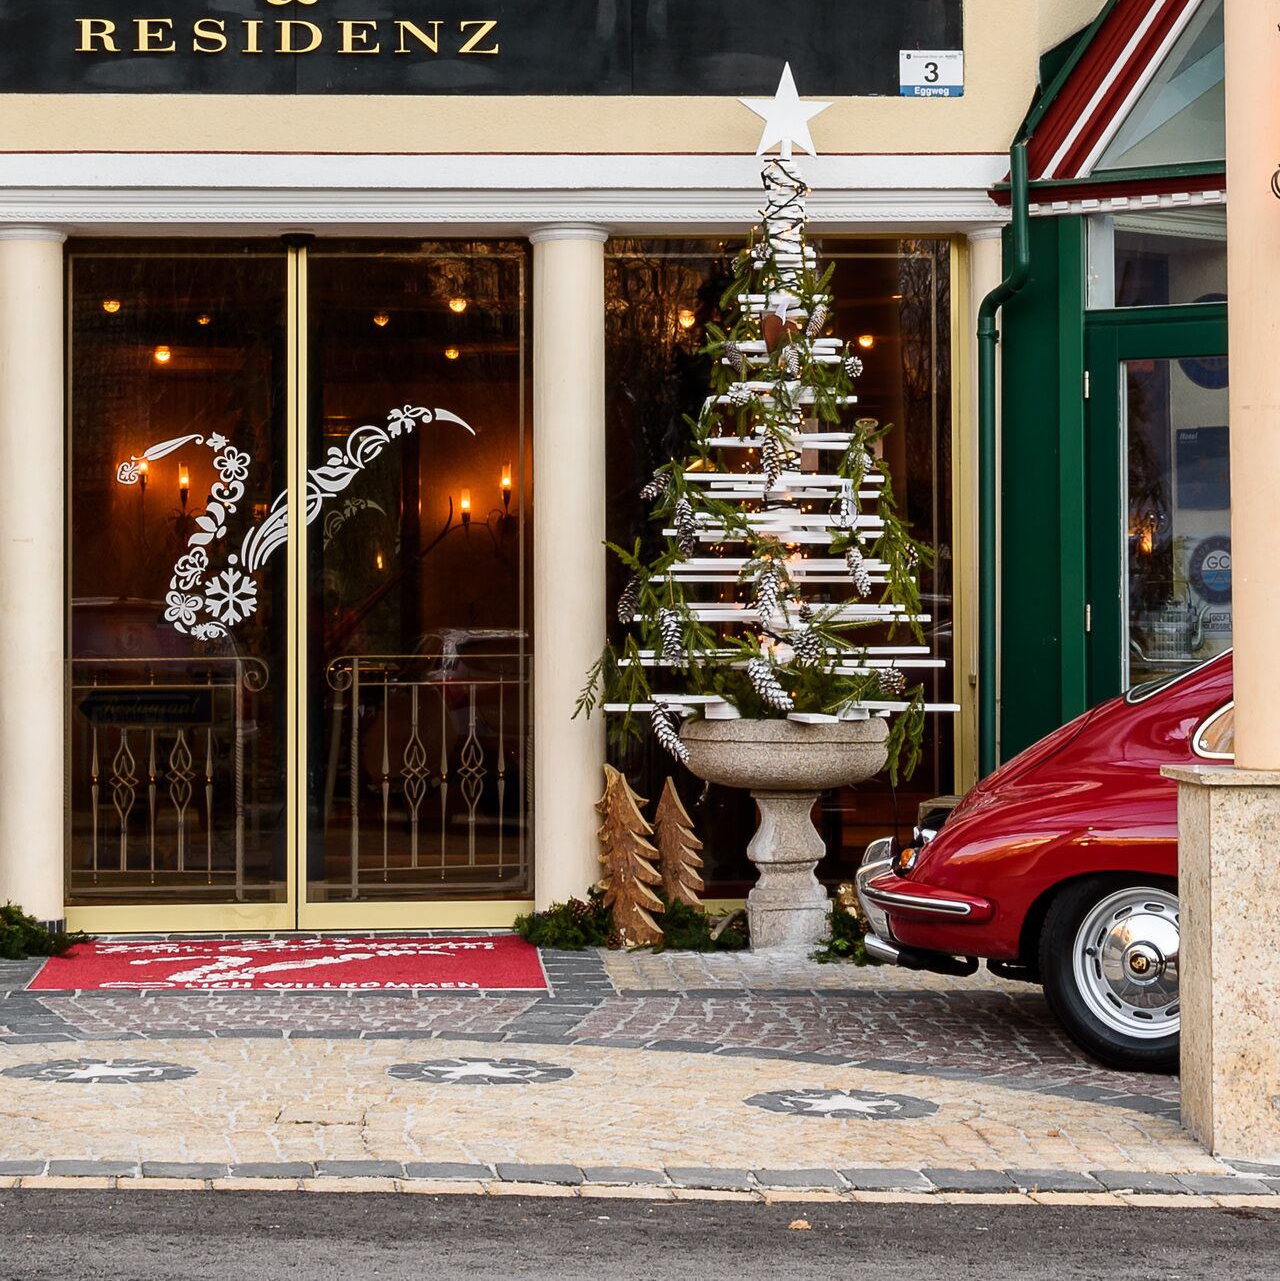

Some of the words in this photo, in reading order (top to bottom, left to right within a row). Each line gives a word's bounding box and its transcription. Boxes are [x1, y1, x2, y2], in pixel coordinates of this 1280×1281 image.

[76, 19, 500, 55] RESIDENZ
[924, 62, 939, 83] 3
[914, 86, 950, 96] Eggweg
[1179, 431, 1199, 440] Hotel
[1206, 556, 1230, 569] GC
[184, 981, 252, 989] LICH
[263, 981, 480, 989] WILLKOMMEN
